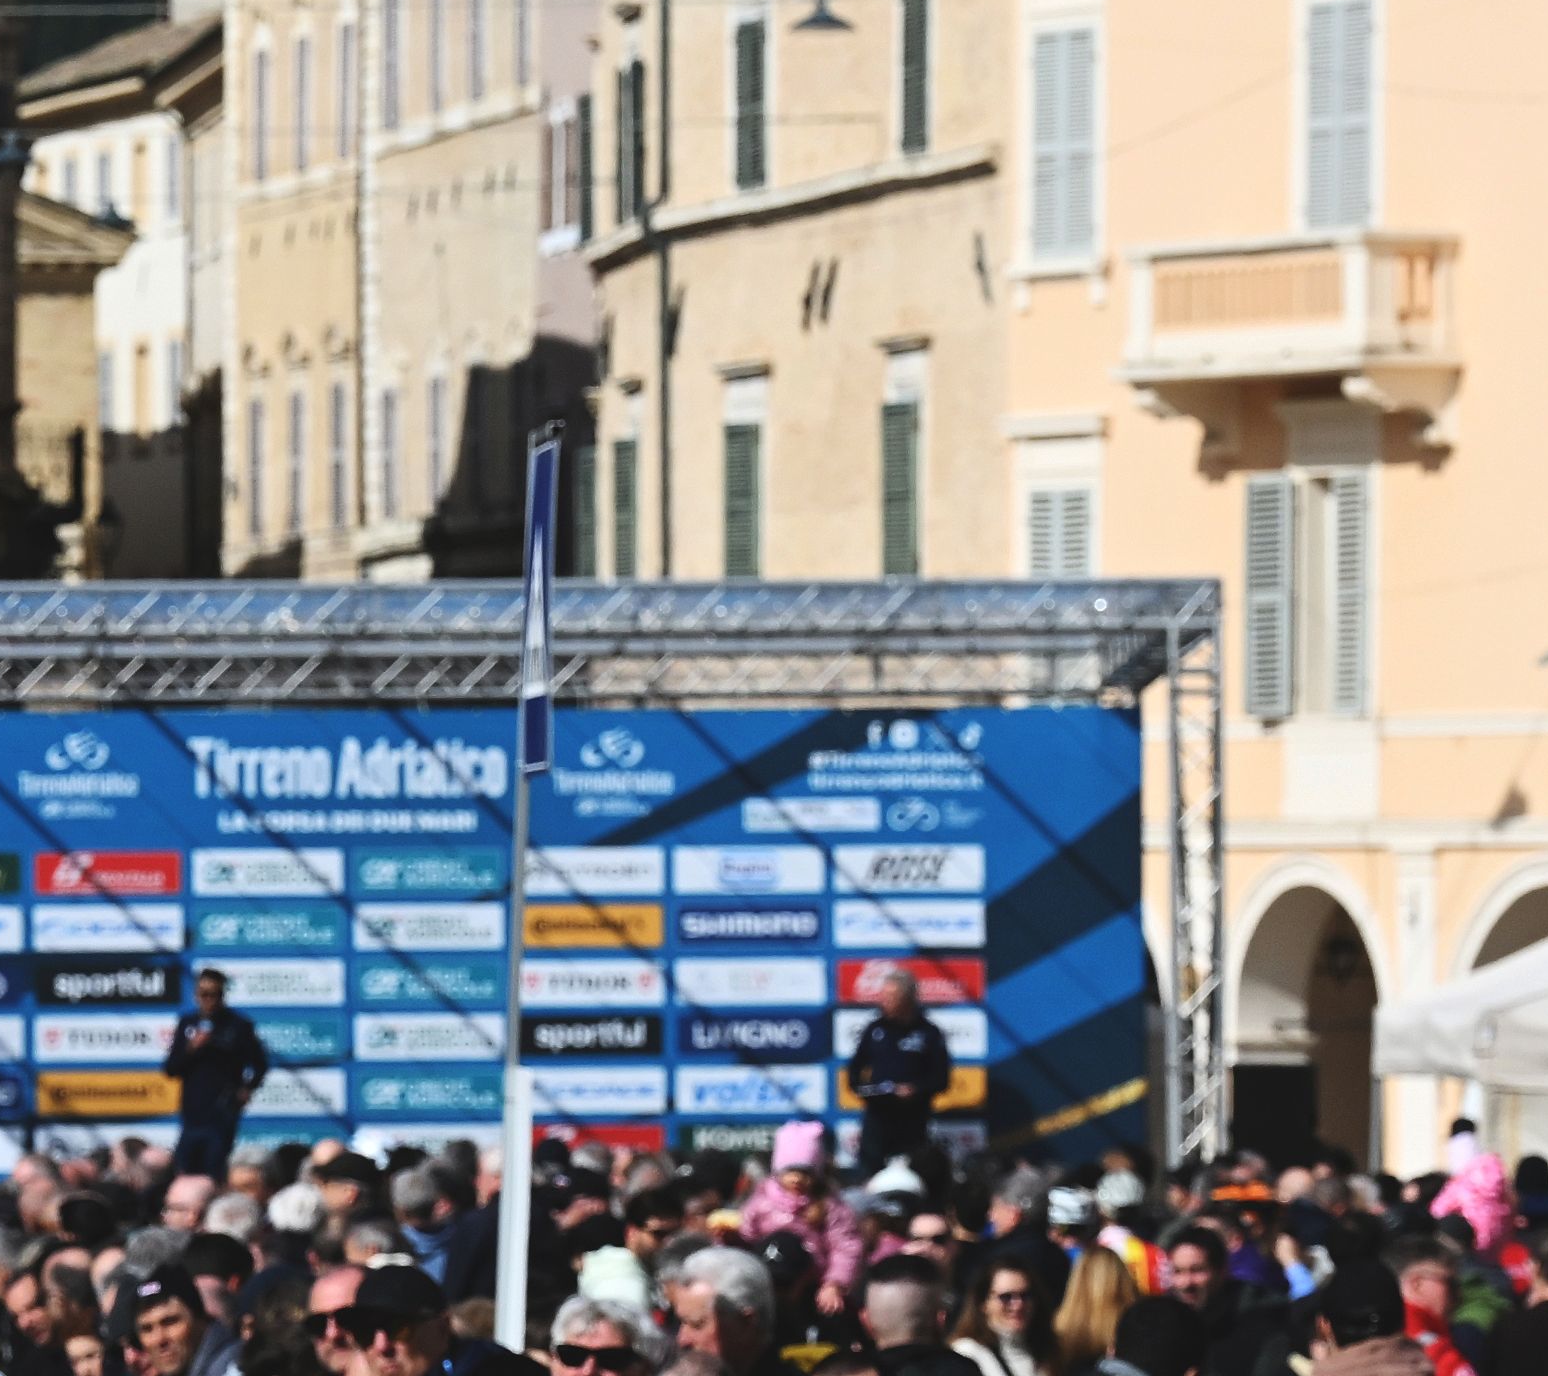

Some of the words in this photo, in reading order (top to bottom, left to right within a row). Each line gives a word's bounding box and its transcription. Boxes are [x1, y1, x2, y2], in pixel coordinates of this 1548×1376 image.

[187, 735, 333, 800] Tirreno
[336, 734, 507, 800] Adriatico
[53, 968, 165, 1002] sportful
[533, 1020, 647, 1051] sportful
